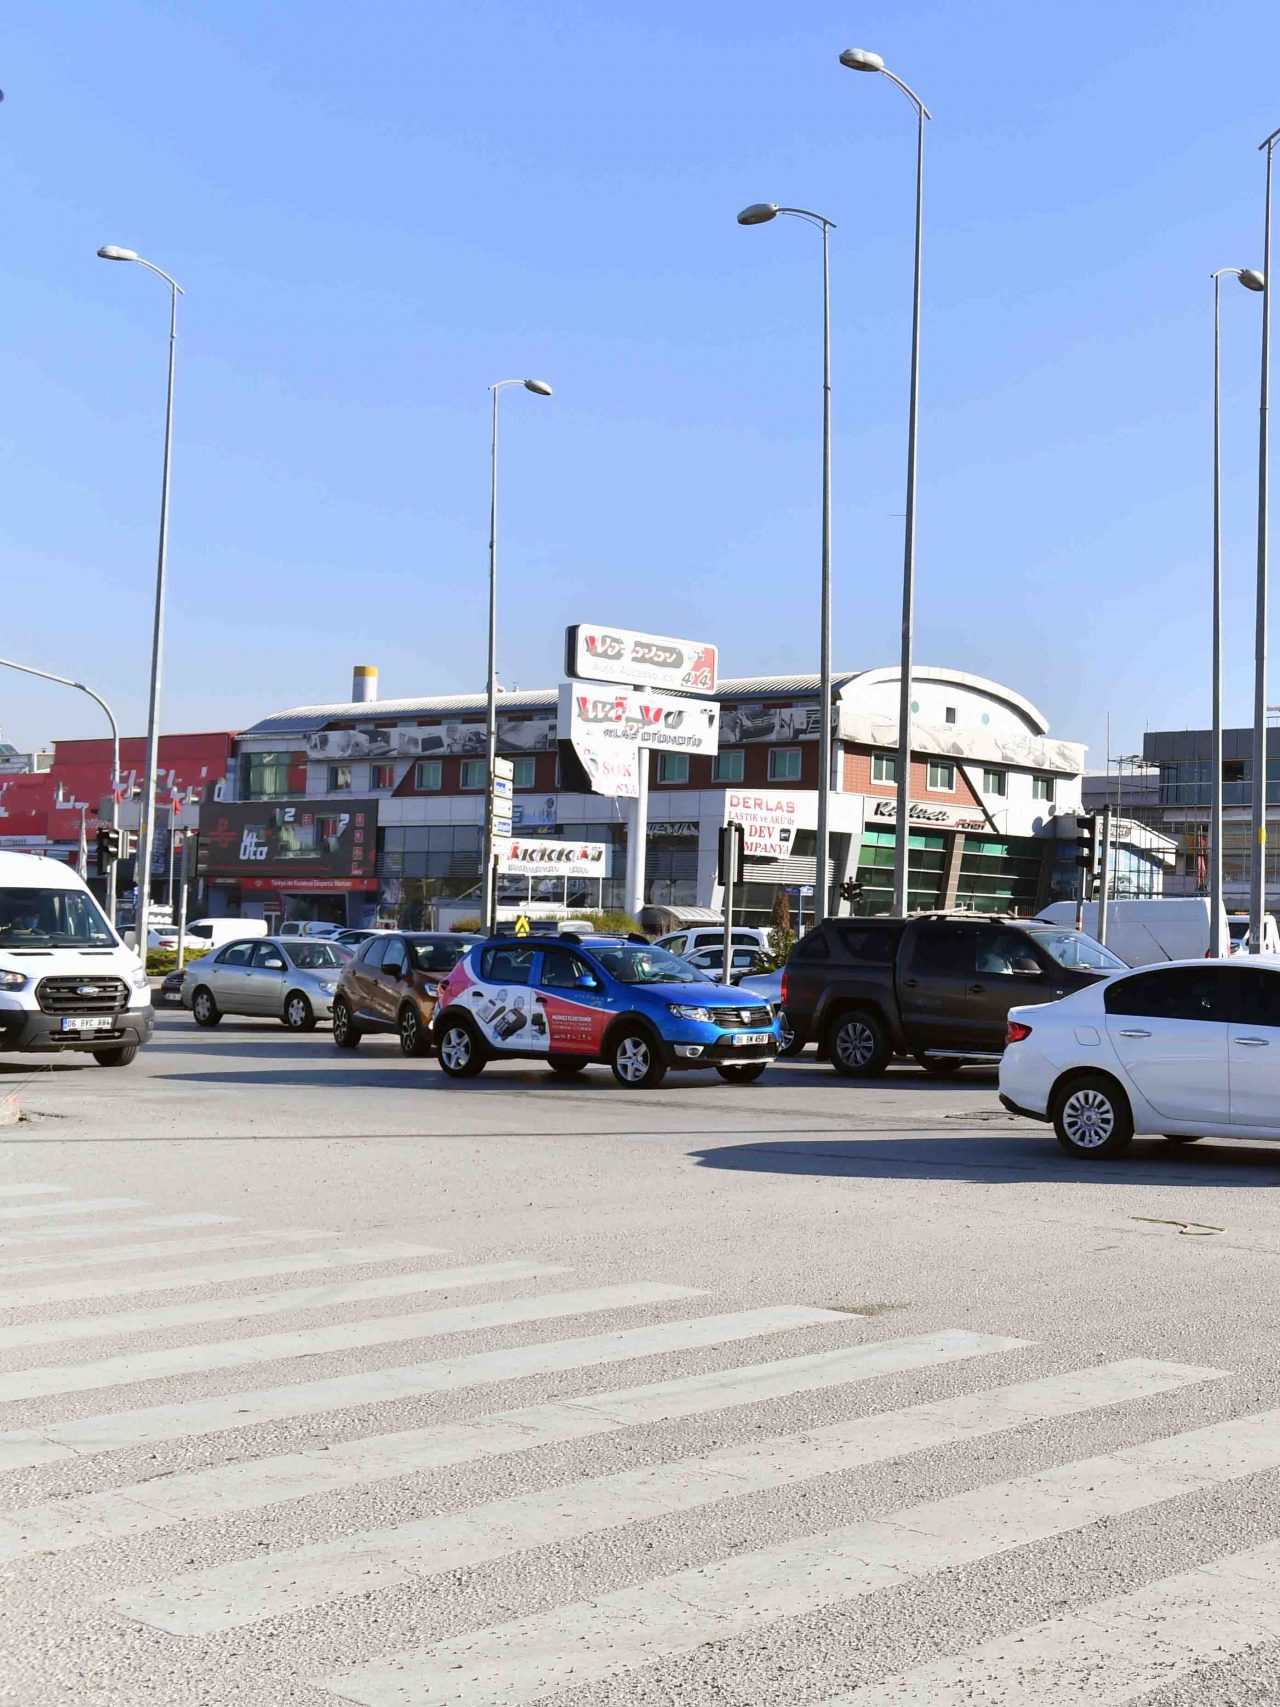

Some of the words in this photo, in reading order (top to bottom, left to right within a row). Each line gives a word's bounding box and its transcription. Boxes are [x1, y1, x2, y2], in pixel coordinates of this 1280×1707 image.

[729, 794, 796, 814] DERLAS
[748, 825, 775, 839] DEV
[67, 1019, 77, 1028] 06
